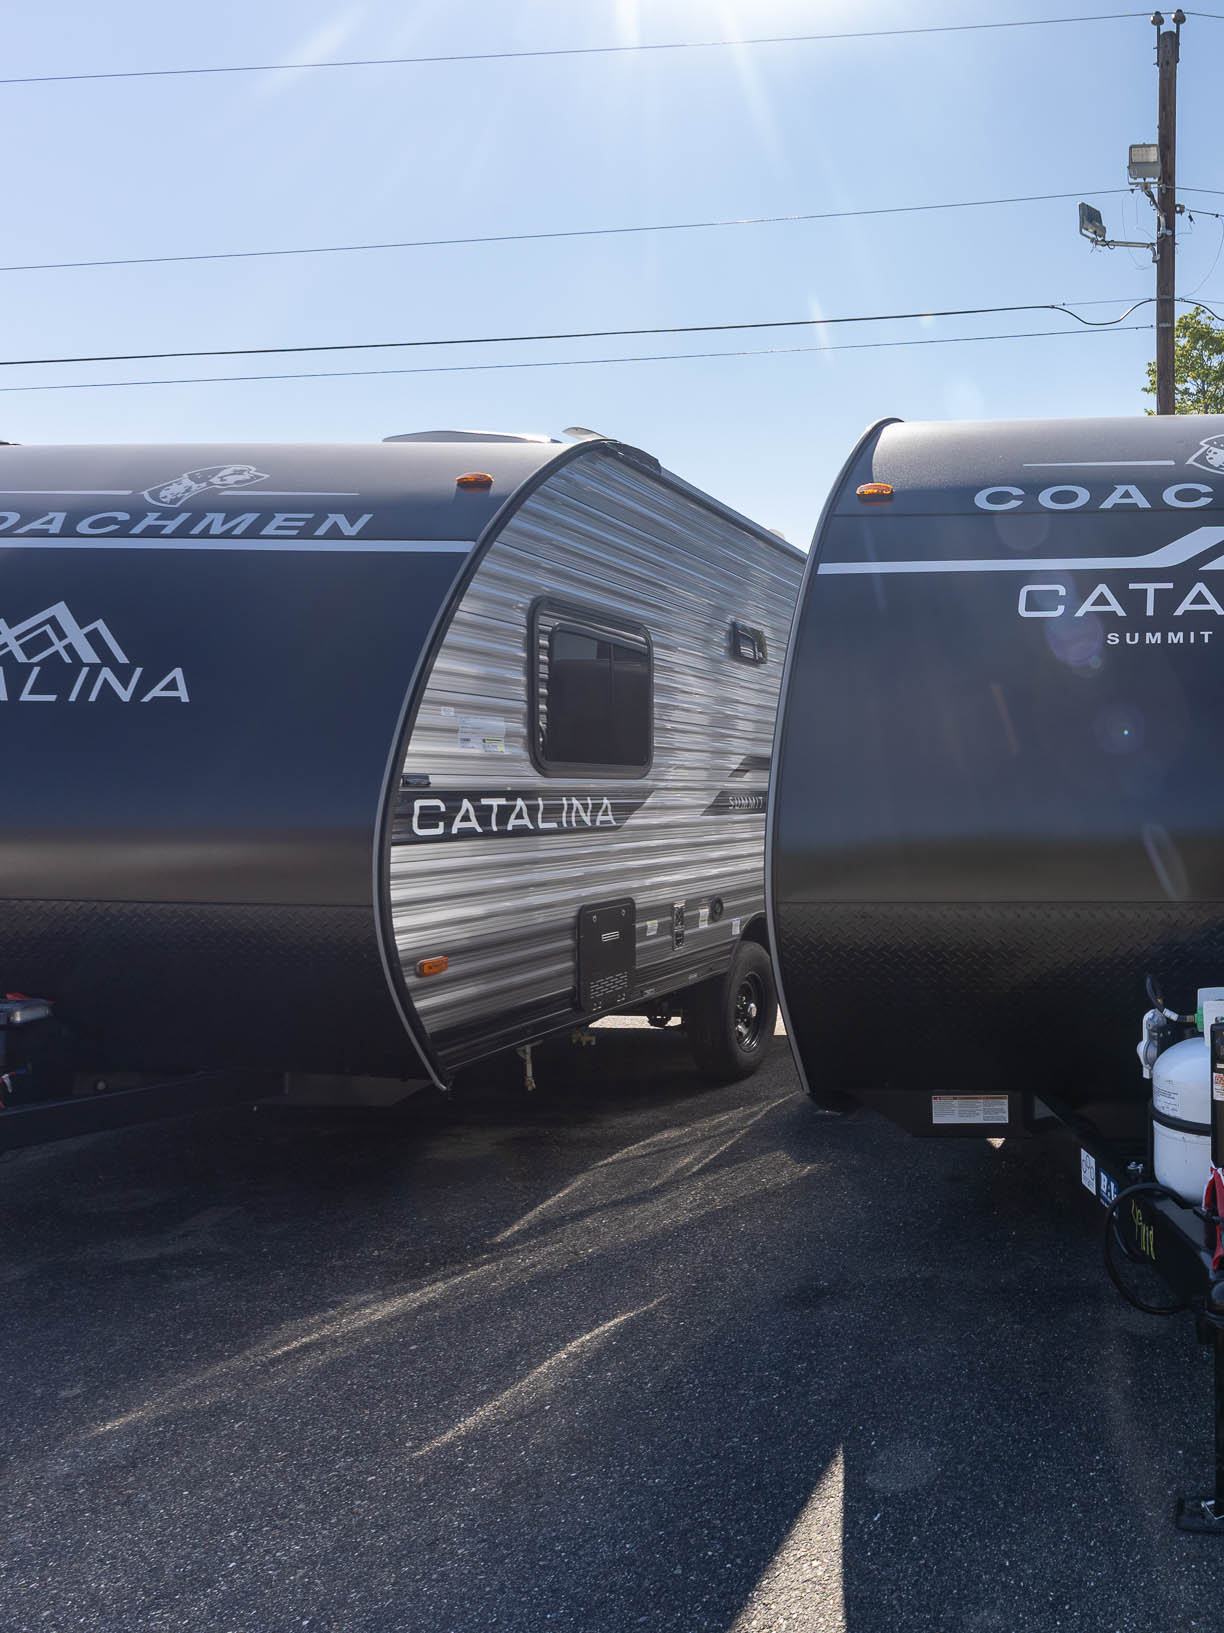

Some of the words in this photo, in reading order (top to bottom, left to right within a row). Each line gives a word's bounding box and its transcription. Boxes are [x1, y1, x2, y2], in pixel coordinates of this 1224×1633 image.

[1106, 630, 1213, 646] SUMMIT
[0, 667, 190, 703] LINA
[412, 796, 617, 836] CATALINA
[728, 796, 763, 810] SUMMIT
